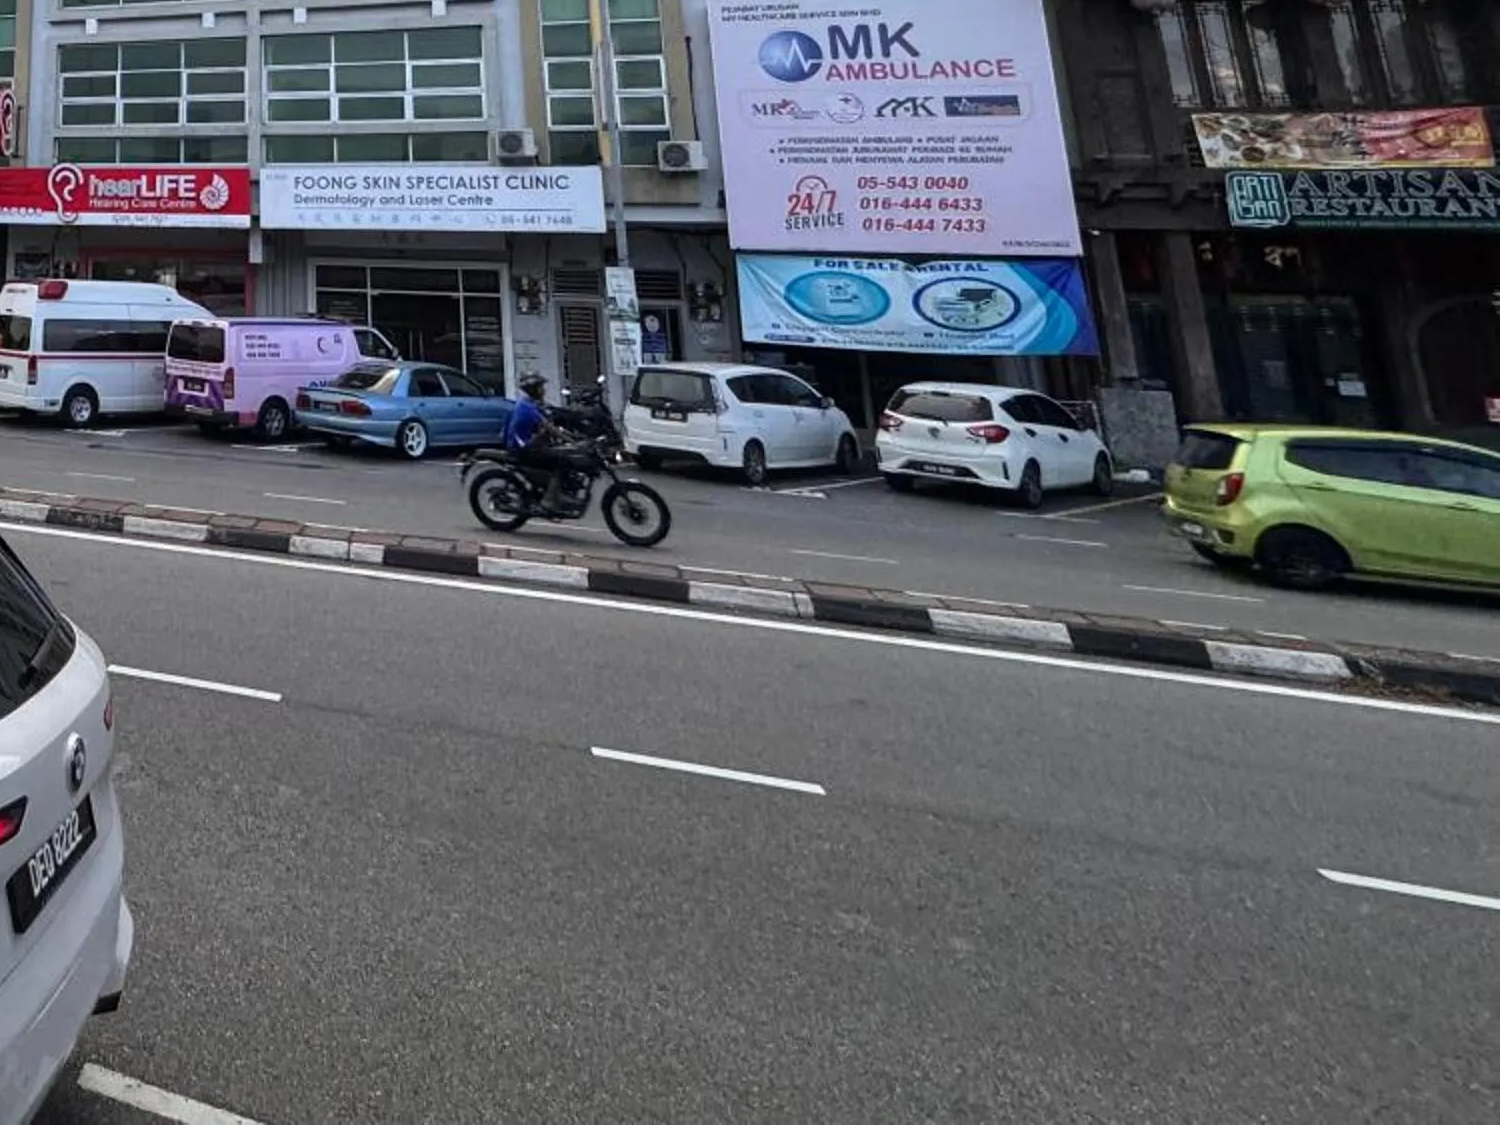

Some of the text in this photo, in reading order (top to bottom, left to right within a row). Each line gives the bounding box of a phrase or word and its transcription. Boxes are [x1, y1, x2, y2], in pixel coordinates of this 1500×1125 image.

[827, 22, 920, 60] MK
[826, 59, 1016, 82] AMBULANCE
[89, 174, 196, 198] hearLIFE
[294, 174, 569, 191] FOONG SKIN SPECIALIST CLINIC
[858, 176, 968, 190] 05-543 0040
[89, 198, 196, 209] Hearing Care Centre
[294, 193, 493, 207] Dermatology and Laser Centre
[788, 190, 836, 215] 24/7
[860, 197, 983, 211] 016-444 6433
[1290, 198, 1500, 217] RESTAURAN
[785, 212, 844, 230] SERVICE
[863, 218, 985, 233] 016-444 7433
[814, 258, 848, 268] FOR
[853, 260, 900, 271] SALE
[53, 810, 82, 865] 8222
